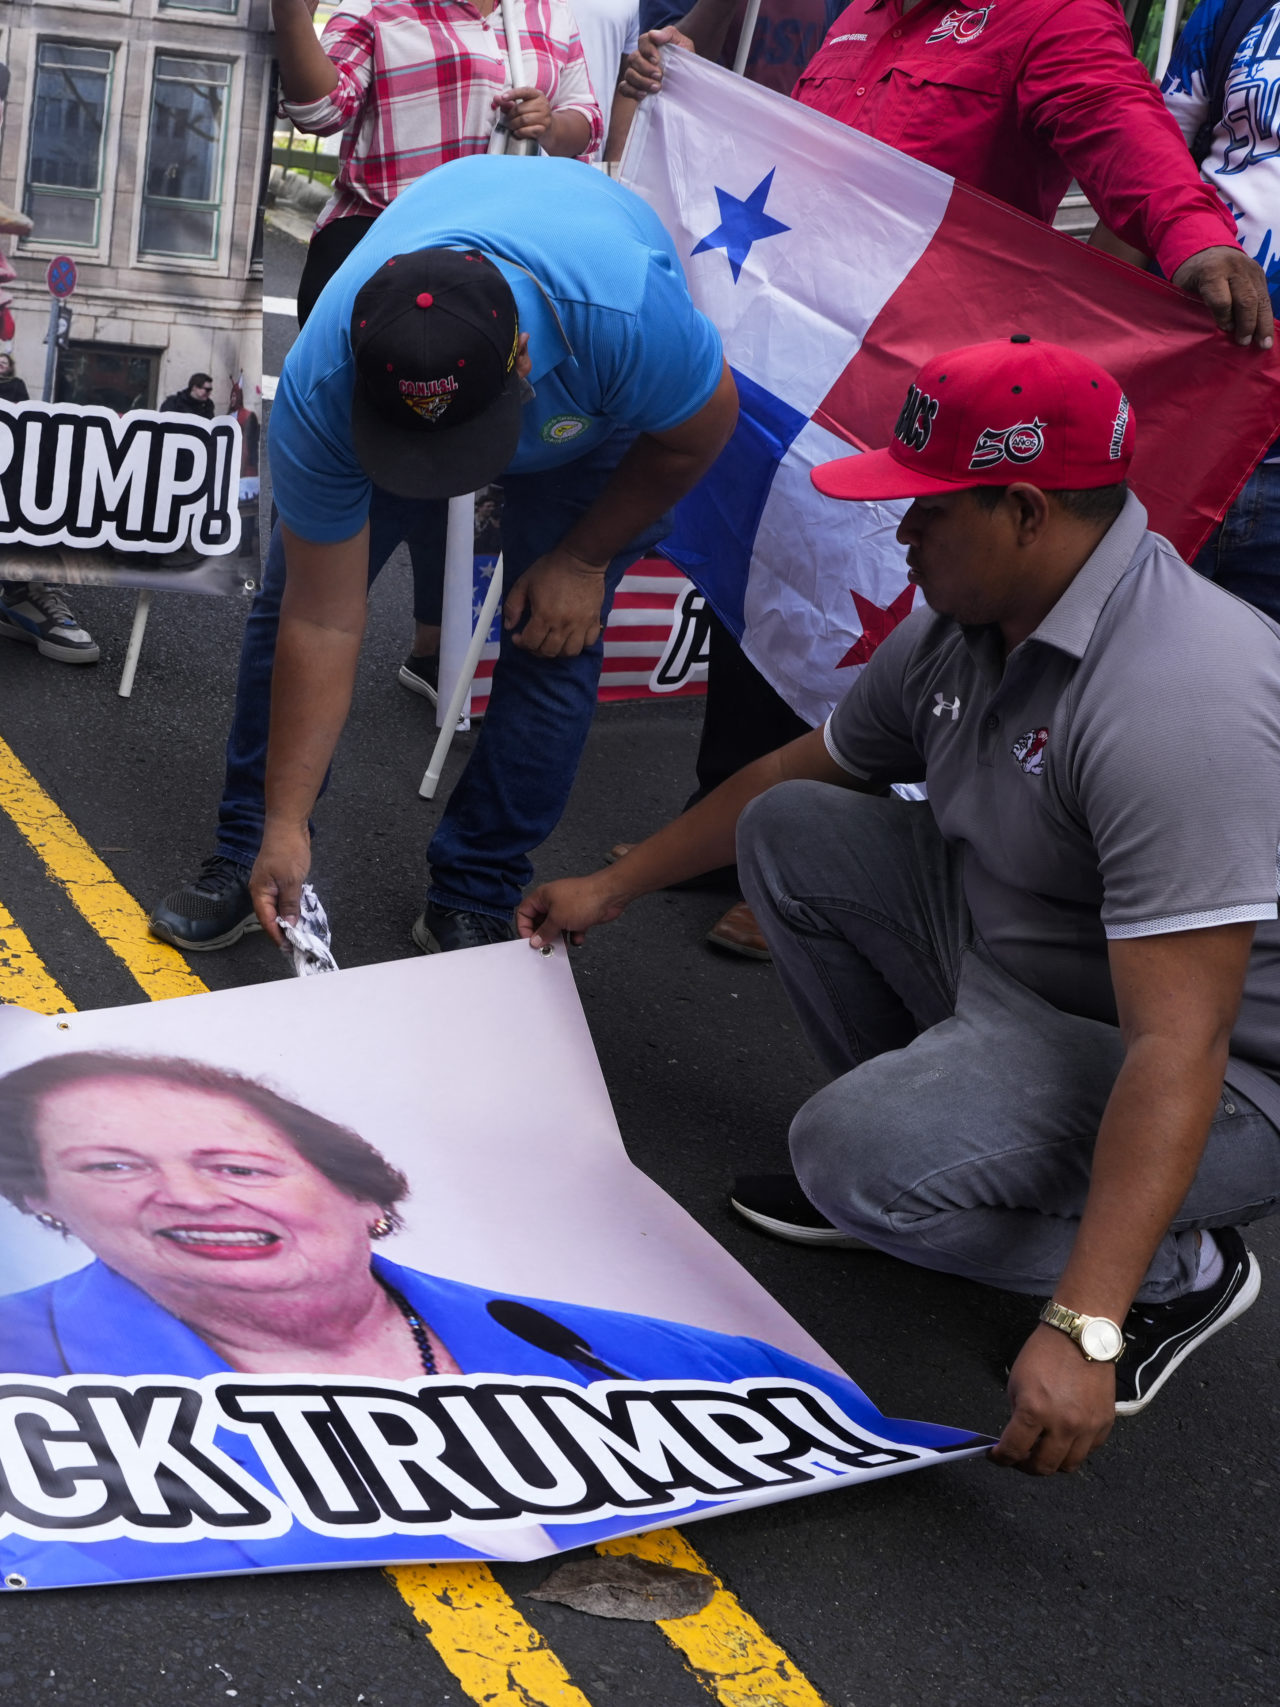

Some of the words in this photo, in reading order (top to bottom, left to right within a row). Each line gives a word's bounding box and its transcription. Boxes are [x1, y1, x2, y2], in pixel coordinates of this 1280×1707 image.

[968, 422, 1045, 470] 50
[1011, 436, 1037, 450] AÑOS
[234, 1393, 879, 1512] TRUMP!
